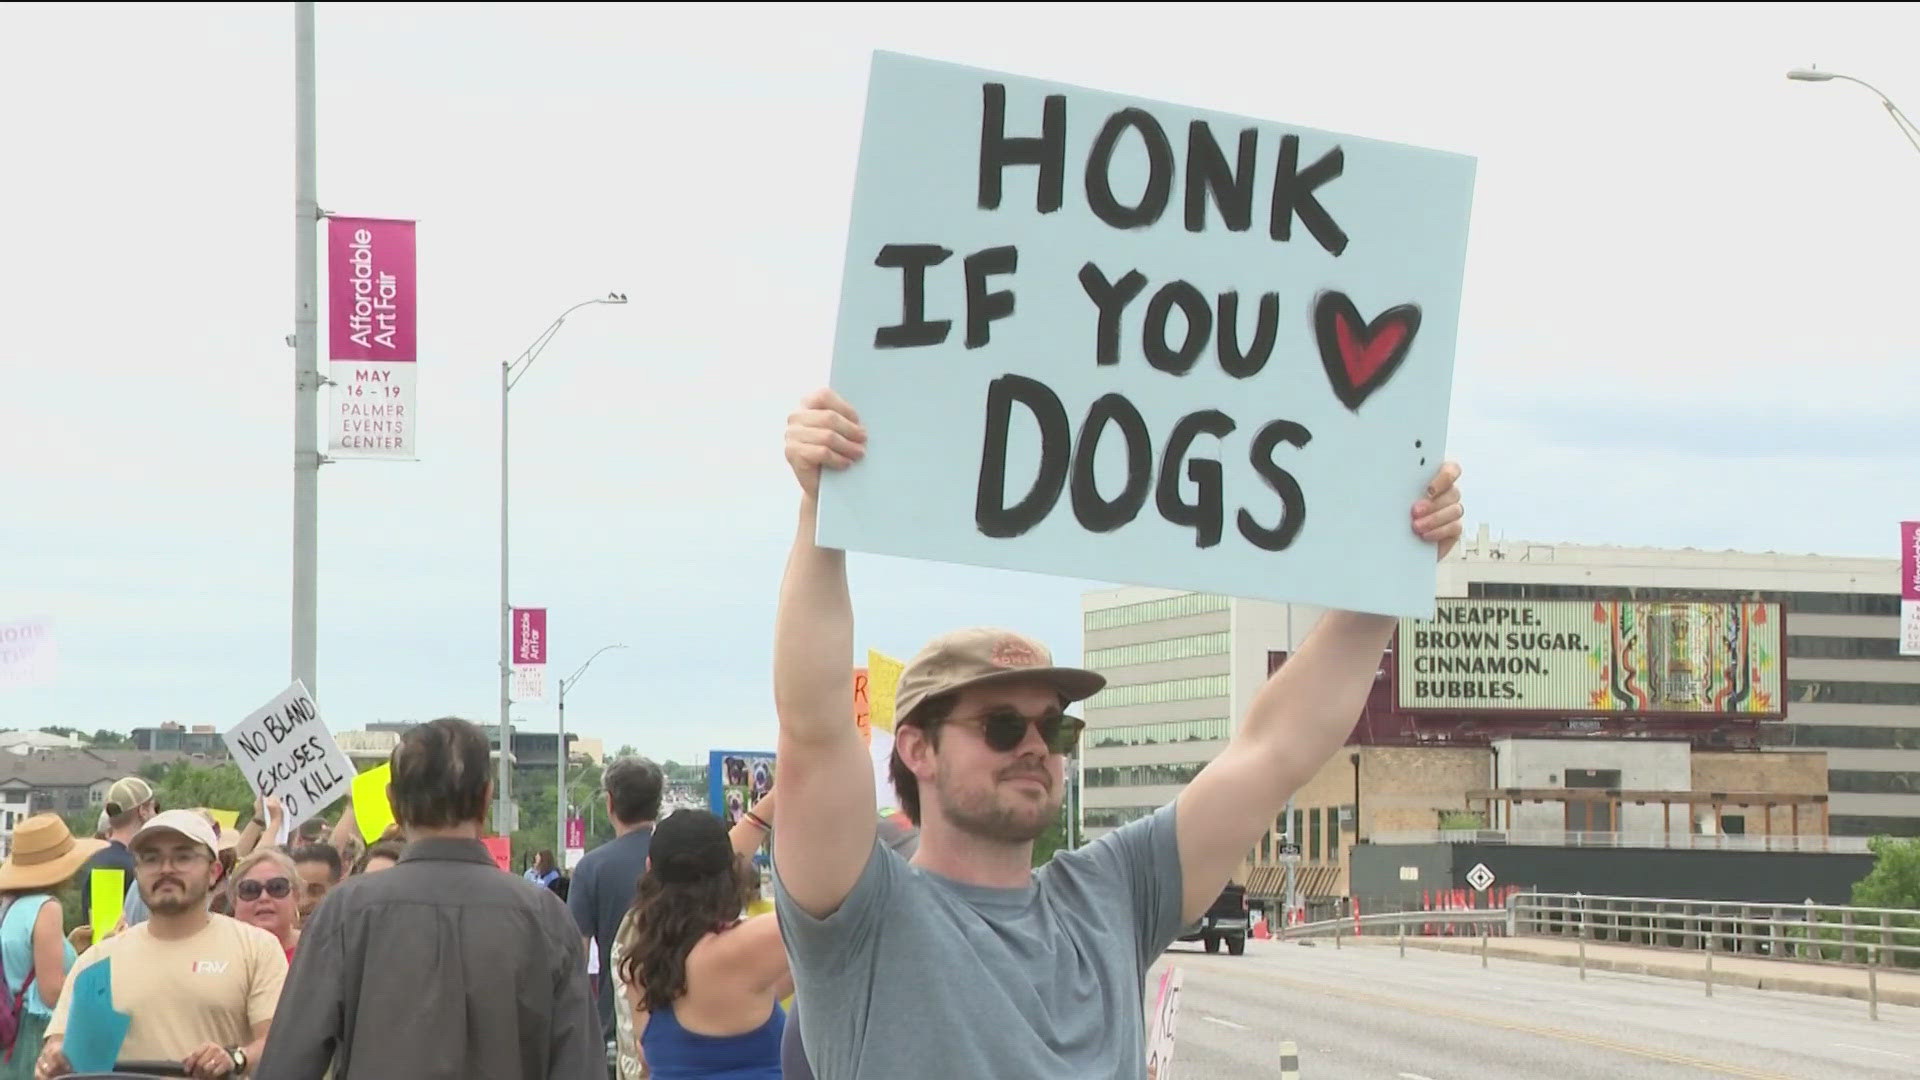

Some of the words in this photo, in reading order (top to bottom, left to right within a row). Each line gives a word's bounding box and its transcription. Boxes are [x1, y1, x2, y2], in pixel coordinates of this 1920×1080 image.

[977, 83, 1348, 257] HONK
[350, 229, 372, 348] Affordable
[374, 271, 397, 309] Fair
[874, 244, 1018, 350] IF
[1078, 261, 1280, 380] YOU
[374, 313, 396, 349] Art
[355, 369, 391, 382] MAY
[347, 384, 363, 396] 16
[385, 386, 401, 398] 19
[341, 403, 404, 416] PALMER
[343, 420, 403, 433] EVENTS
[341, 435, 403, 448] CENTER
[975, 373, 1312, 553] DOGS
[1415, 606, 1542, 626] NEAPPLE.
[1415, 631, 1499, 650] BROWN
[1506, 632, 1590, 651] SUGAR.
[1414, 656, 1549, 676] CINNAMON.
[1415, 680, 1523, 700] BUBBLES.
[237, 731, 267, 762] NO
[263, 696, 316, 744] BLAND
[257, 735, 326, 797] EXCUSES
[299, 763, 343, 804] KILL
